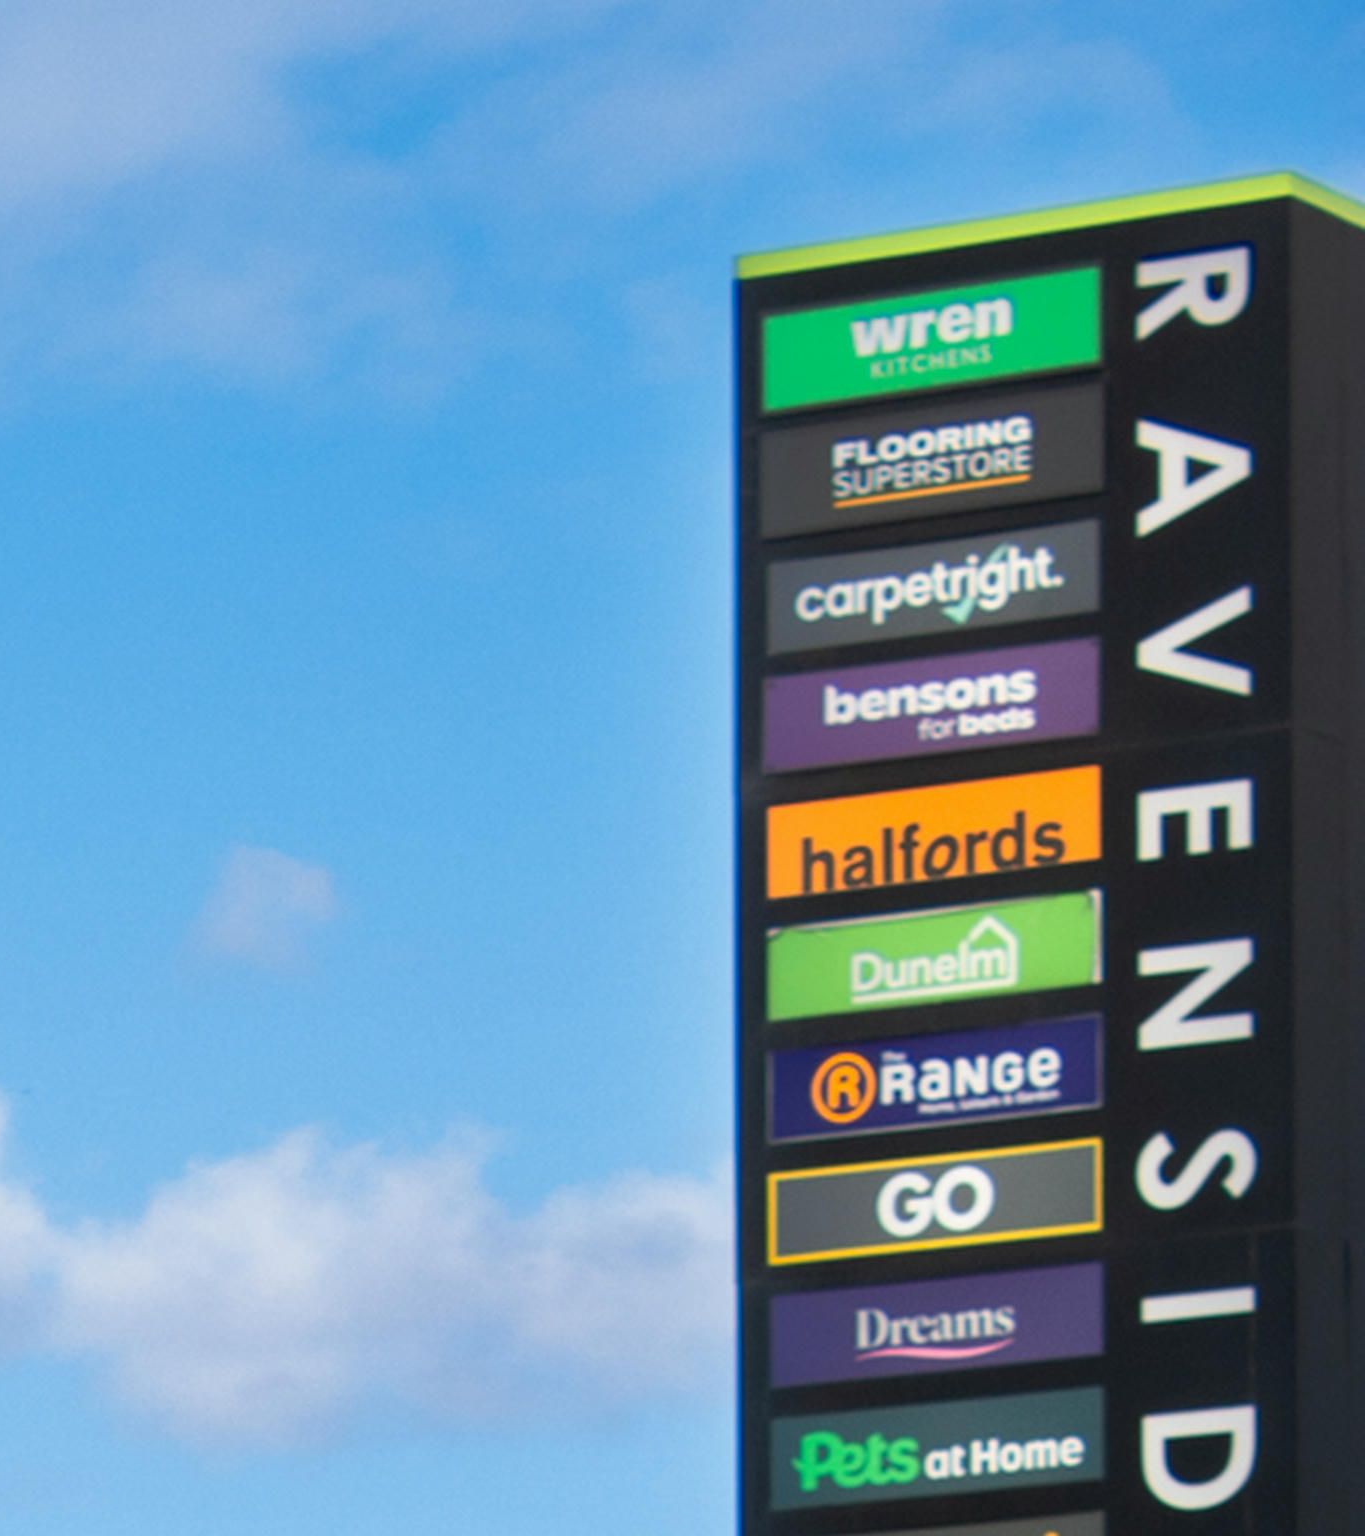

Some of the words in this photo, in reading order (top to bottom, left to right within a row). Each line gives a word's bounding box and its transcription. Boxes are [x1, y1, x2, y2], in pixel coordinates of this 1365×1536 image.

[850, 296, 1013, 359] wren
[869, 343, 993, 379] KITCHENS
[832, 416, 1033, 469] FLOORING
[832, 443, 1034, 498] SUPERSTORE
[823, 668, 1037, 725] bensons
[917, 717, 956, 741] for
[957, 705, 1036, 738] beds
[801, 811, 1067, 893] halfords
[851, 938, 1012, 994] Dunelm
[876, 1164, 995, 1238] GO
[855, 1306, 1016, 1351] Dreams
[792, 1430, 919, 1492] Pets
[923, 1441, 967, 1480] at
[970, 1433, 1085, 1475] Home
